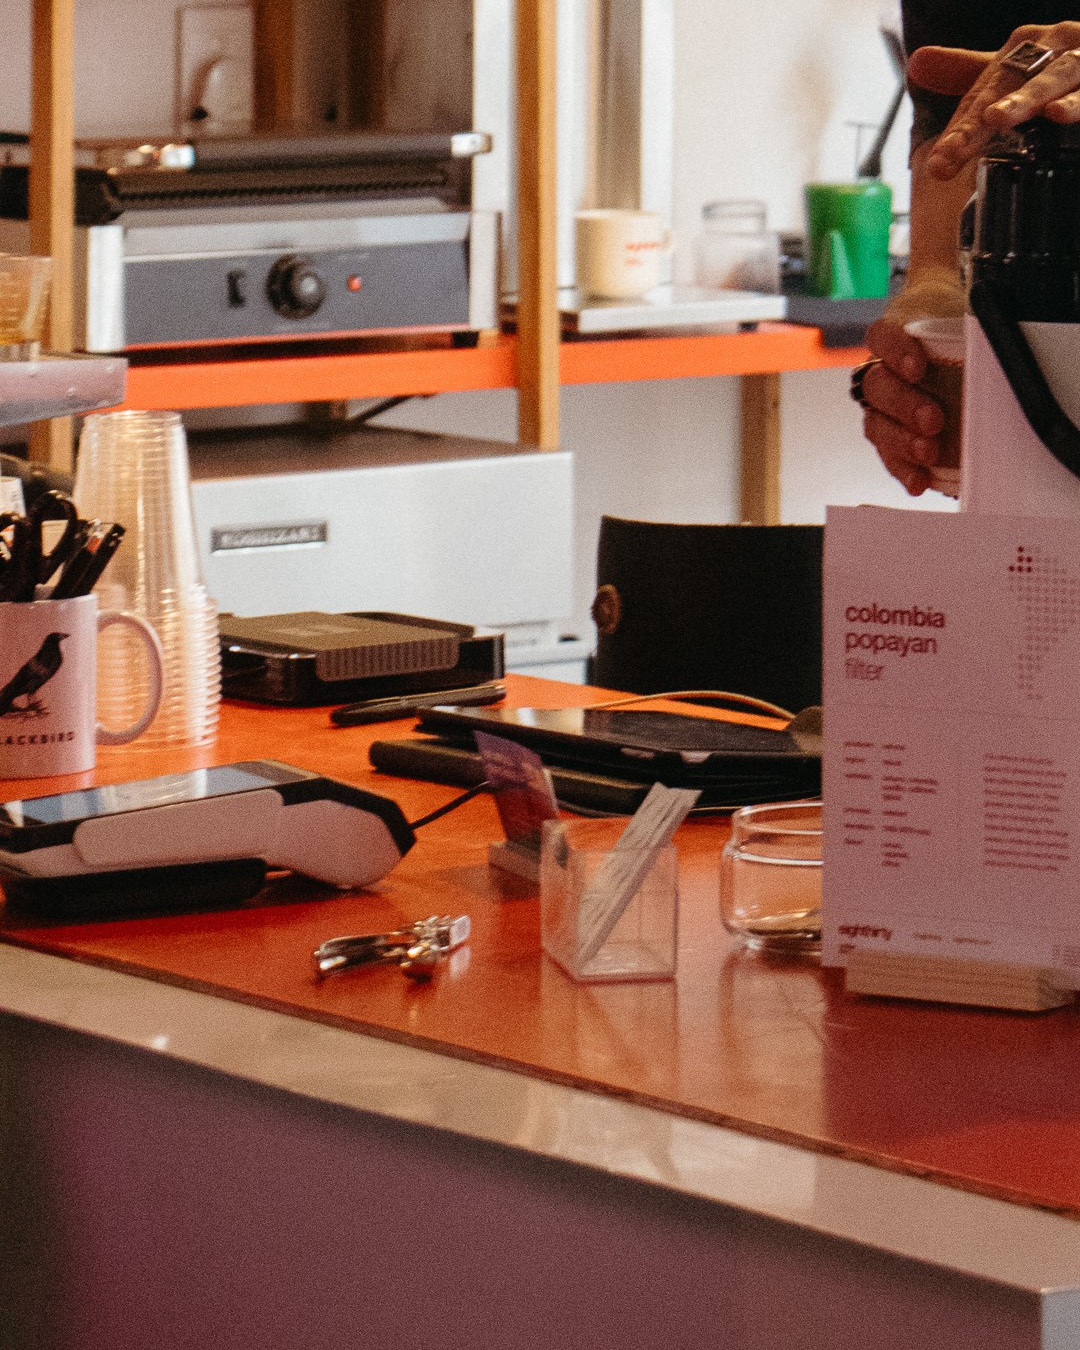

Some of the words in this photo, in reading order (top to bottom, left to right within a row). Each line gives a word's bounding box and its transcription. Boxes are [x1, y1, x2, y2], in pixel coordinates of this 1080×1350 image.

[845, 603, 945, 628] colombia
[845, 633, 938, 657] popayan
[845, 658, 884, 680] filter
